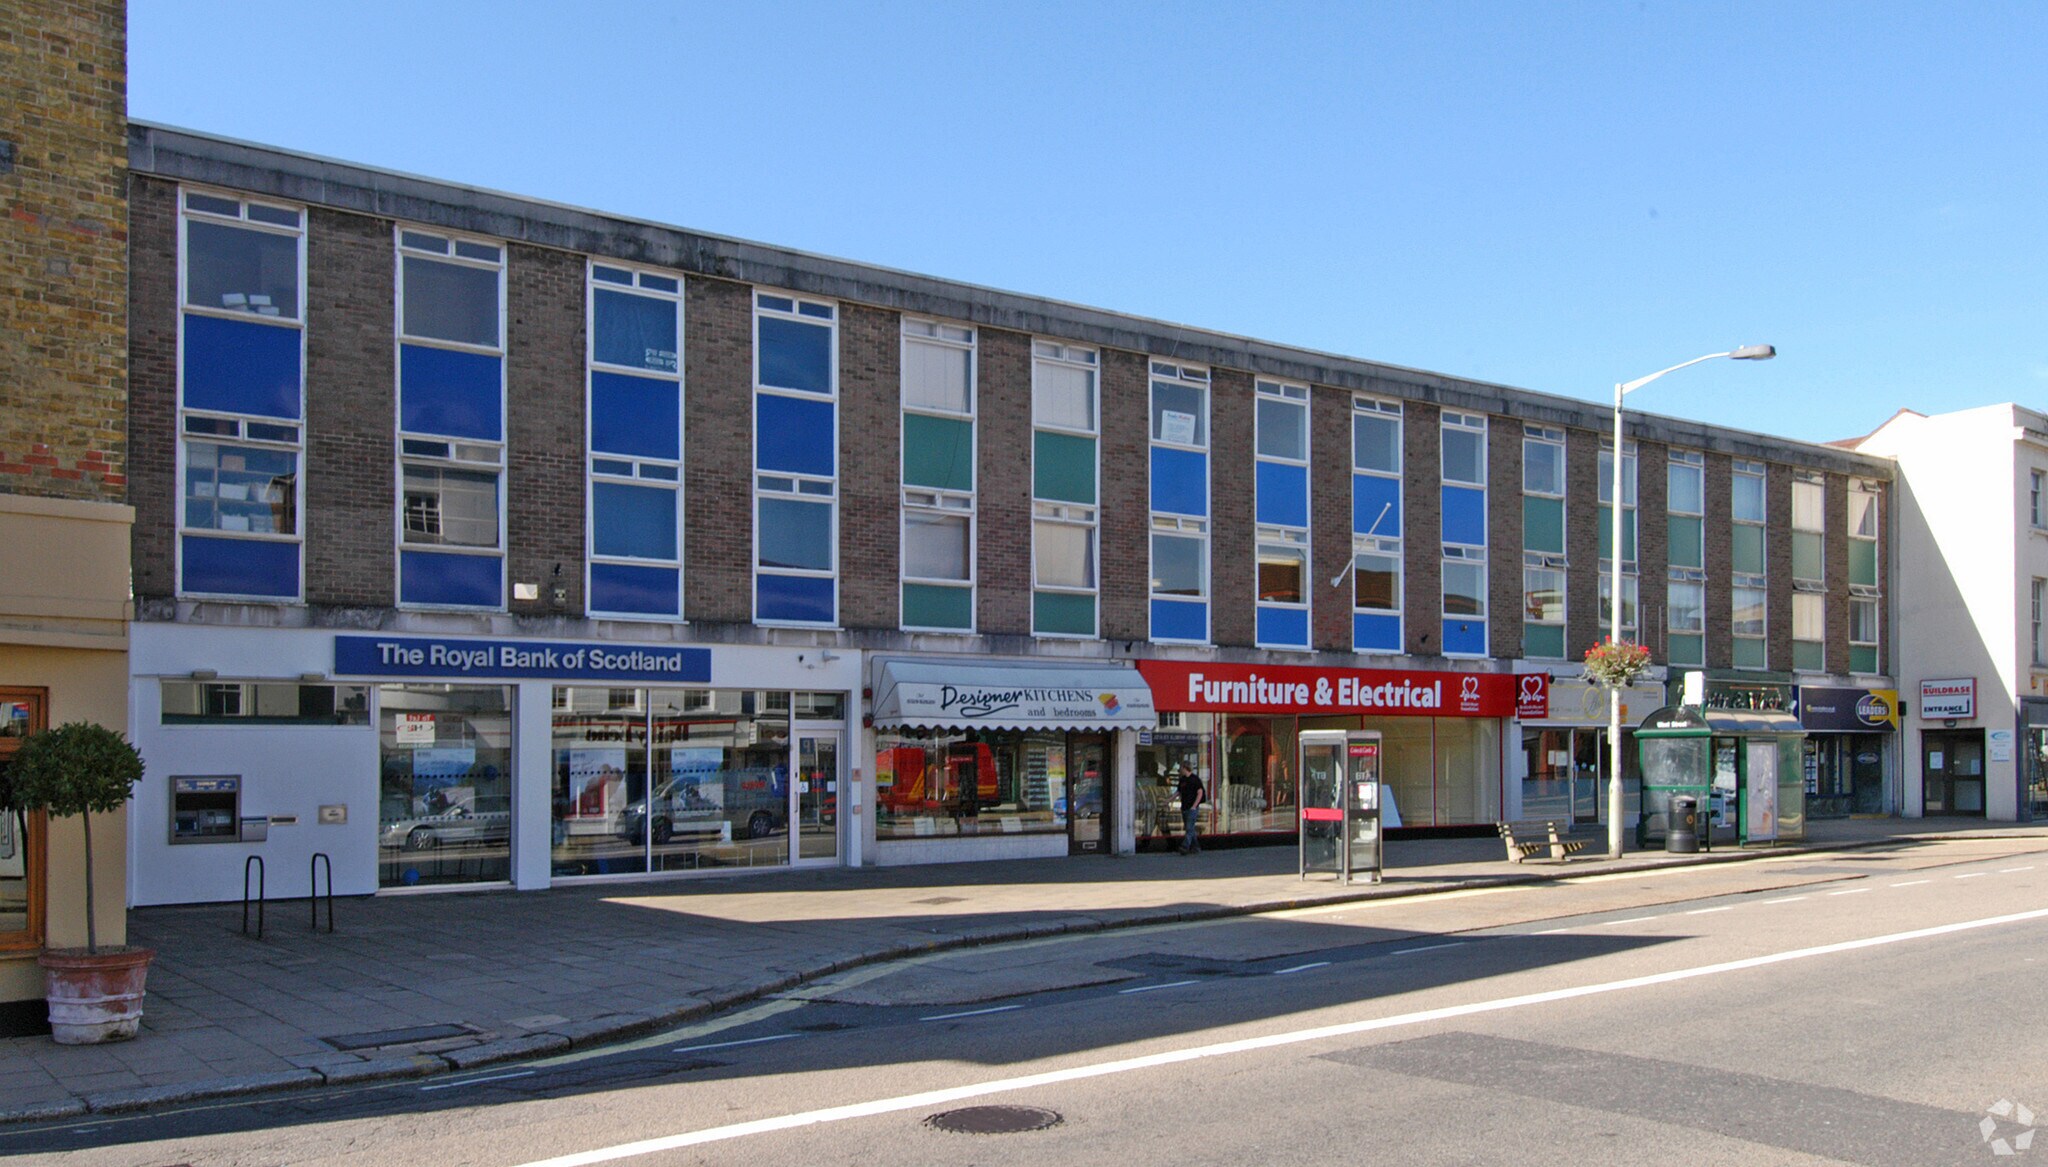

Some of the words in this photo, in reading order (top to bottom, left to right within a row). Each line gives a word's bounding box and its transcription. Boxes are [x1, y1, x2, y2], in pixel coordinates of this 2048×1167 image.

[377, 642, 424, 666] The
[430, 645, 494, 671] Royal
[501, 647, 558, 669] Bank
[562, 649, 584, 669] of
[589, 650, 682, 672] Scotland
[940, 684, 1024, 717] Designer
[1024, 689, 1093, 702] KITCHENS
[1188, 673, 1309, 705] Furniture
[1314, 677, 1333, 705] &
[1338, 678, 1441, 708] Electrical
[1923, 686, 1971, 695] BUILDBASE
[1027, 707, 1046, 717] and
[1054, 706, 1097, 718] bedrooms
[1924, 705, 1963, 713] ENTRANCE
